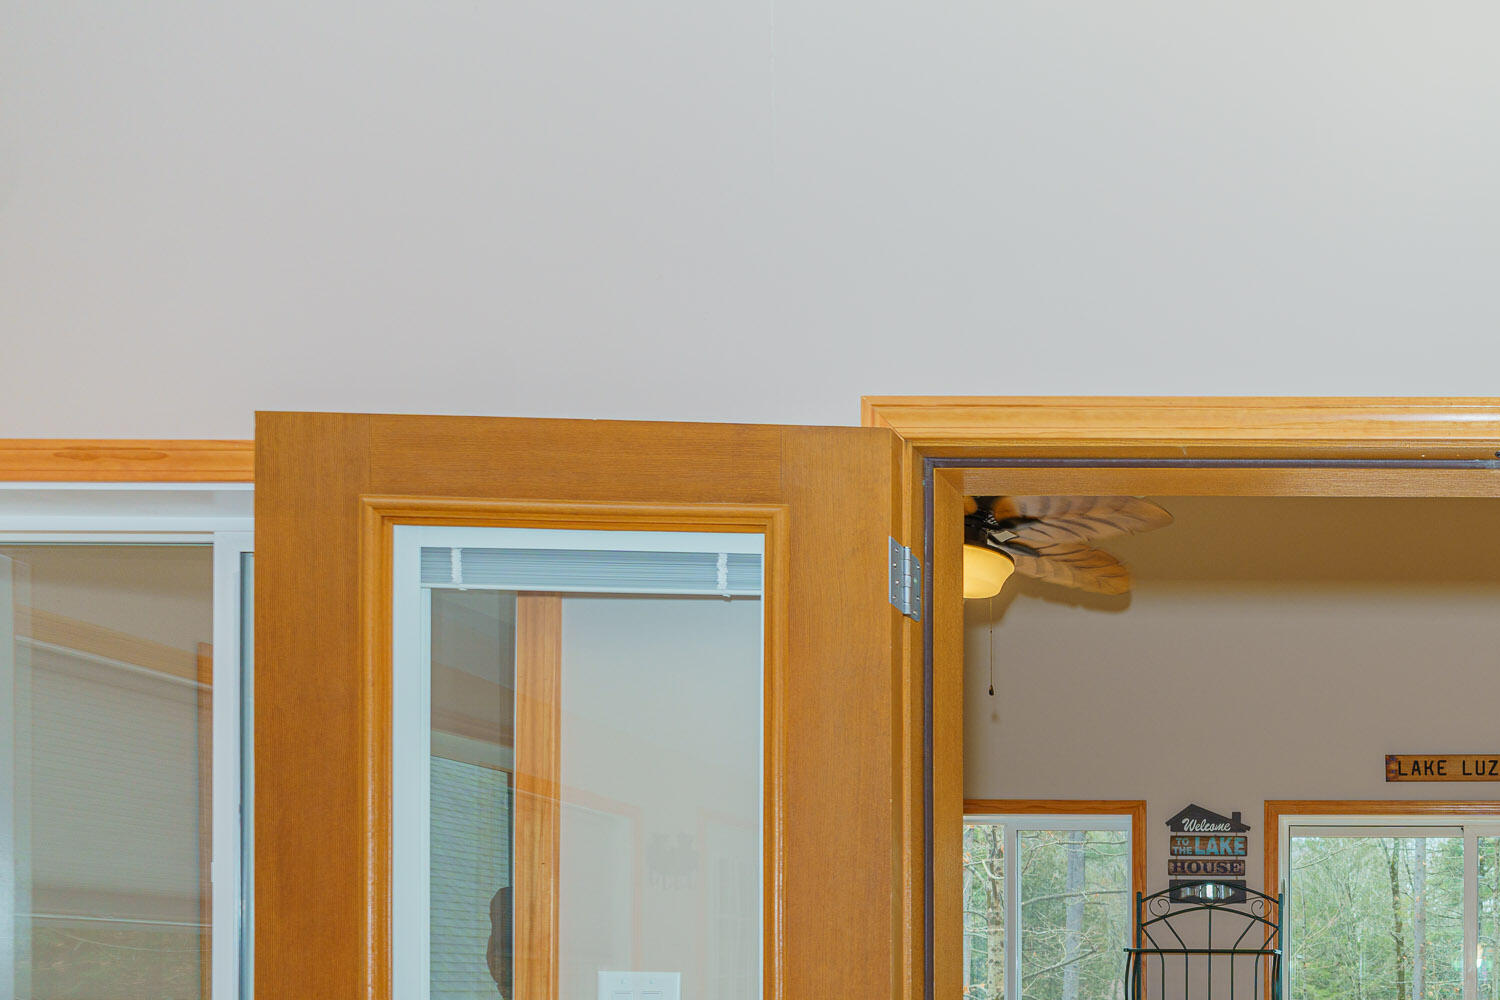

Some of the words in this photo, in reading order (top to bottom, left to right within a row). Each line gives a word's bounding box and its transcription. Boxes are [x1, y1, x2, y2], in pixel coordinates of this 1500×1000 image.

[1397, 759, 1447, 776] LAKE
[1181, 817, 1232, 832] Welcome
[1175, 837, 1190, 846] TO
[1194, 836, 1246, 856] LAKE
[1172, 846, 1193, 855] THE
[1172, 861, 1242, 874] HOUSE
